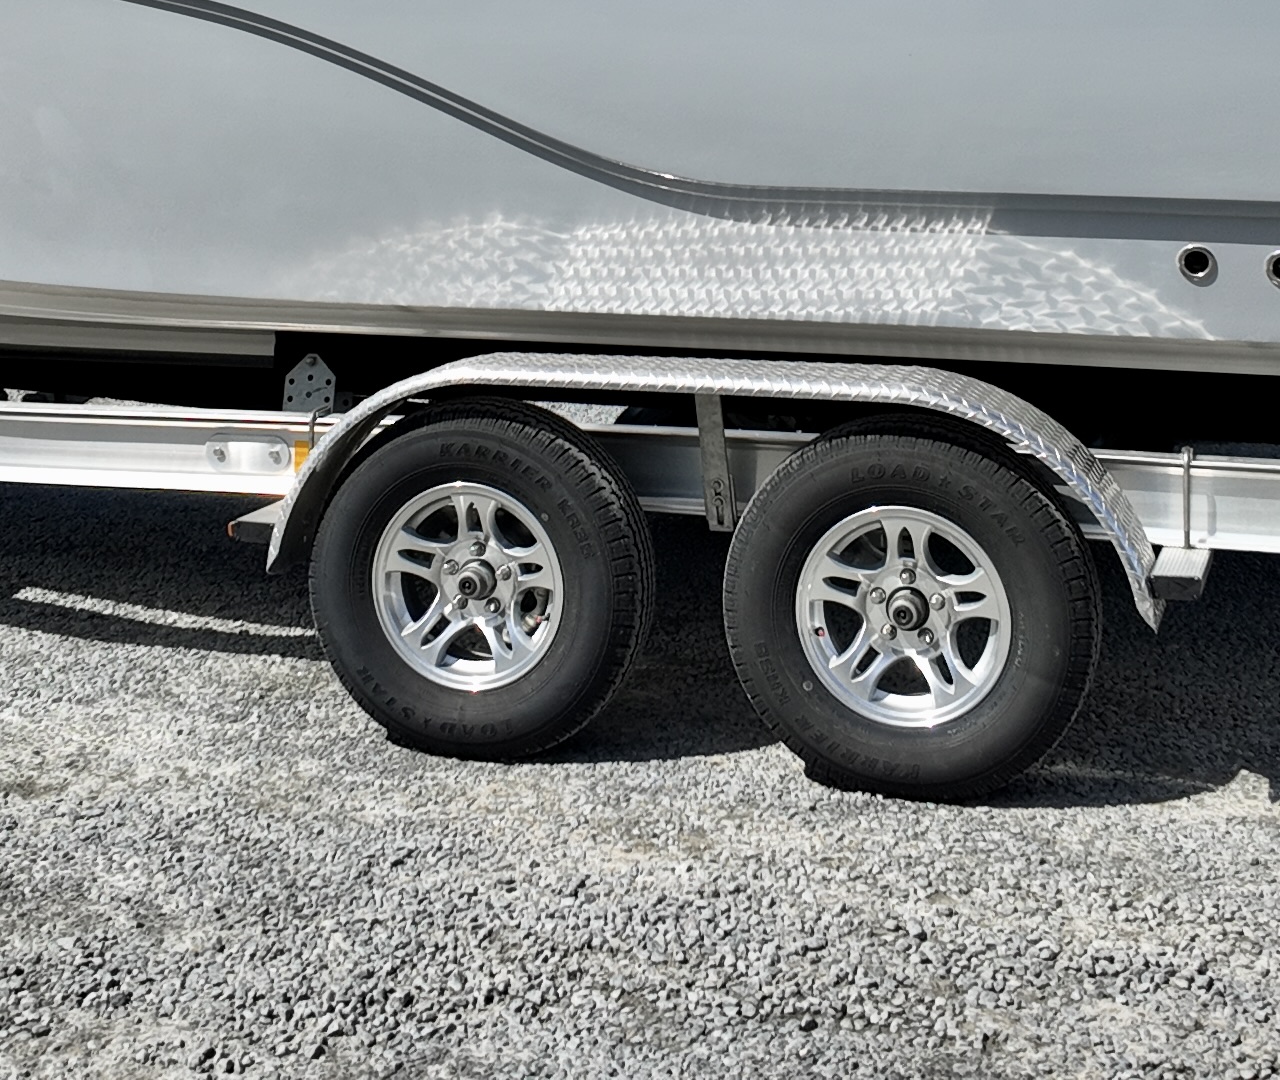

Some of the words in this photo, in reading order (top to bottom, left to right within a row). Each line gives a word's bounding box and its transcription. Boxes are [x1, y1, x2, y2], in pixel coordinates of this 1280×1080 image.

[439, 442, 553, 492] KARRIER
[849, 463, 931, 484] LOAD
[957, 484, 1026, 548] STAR
